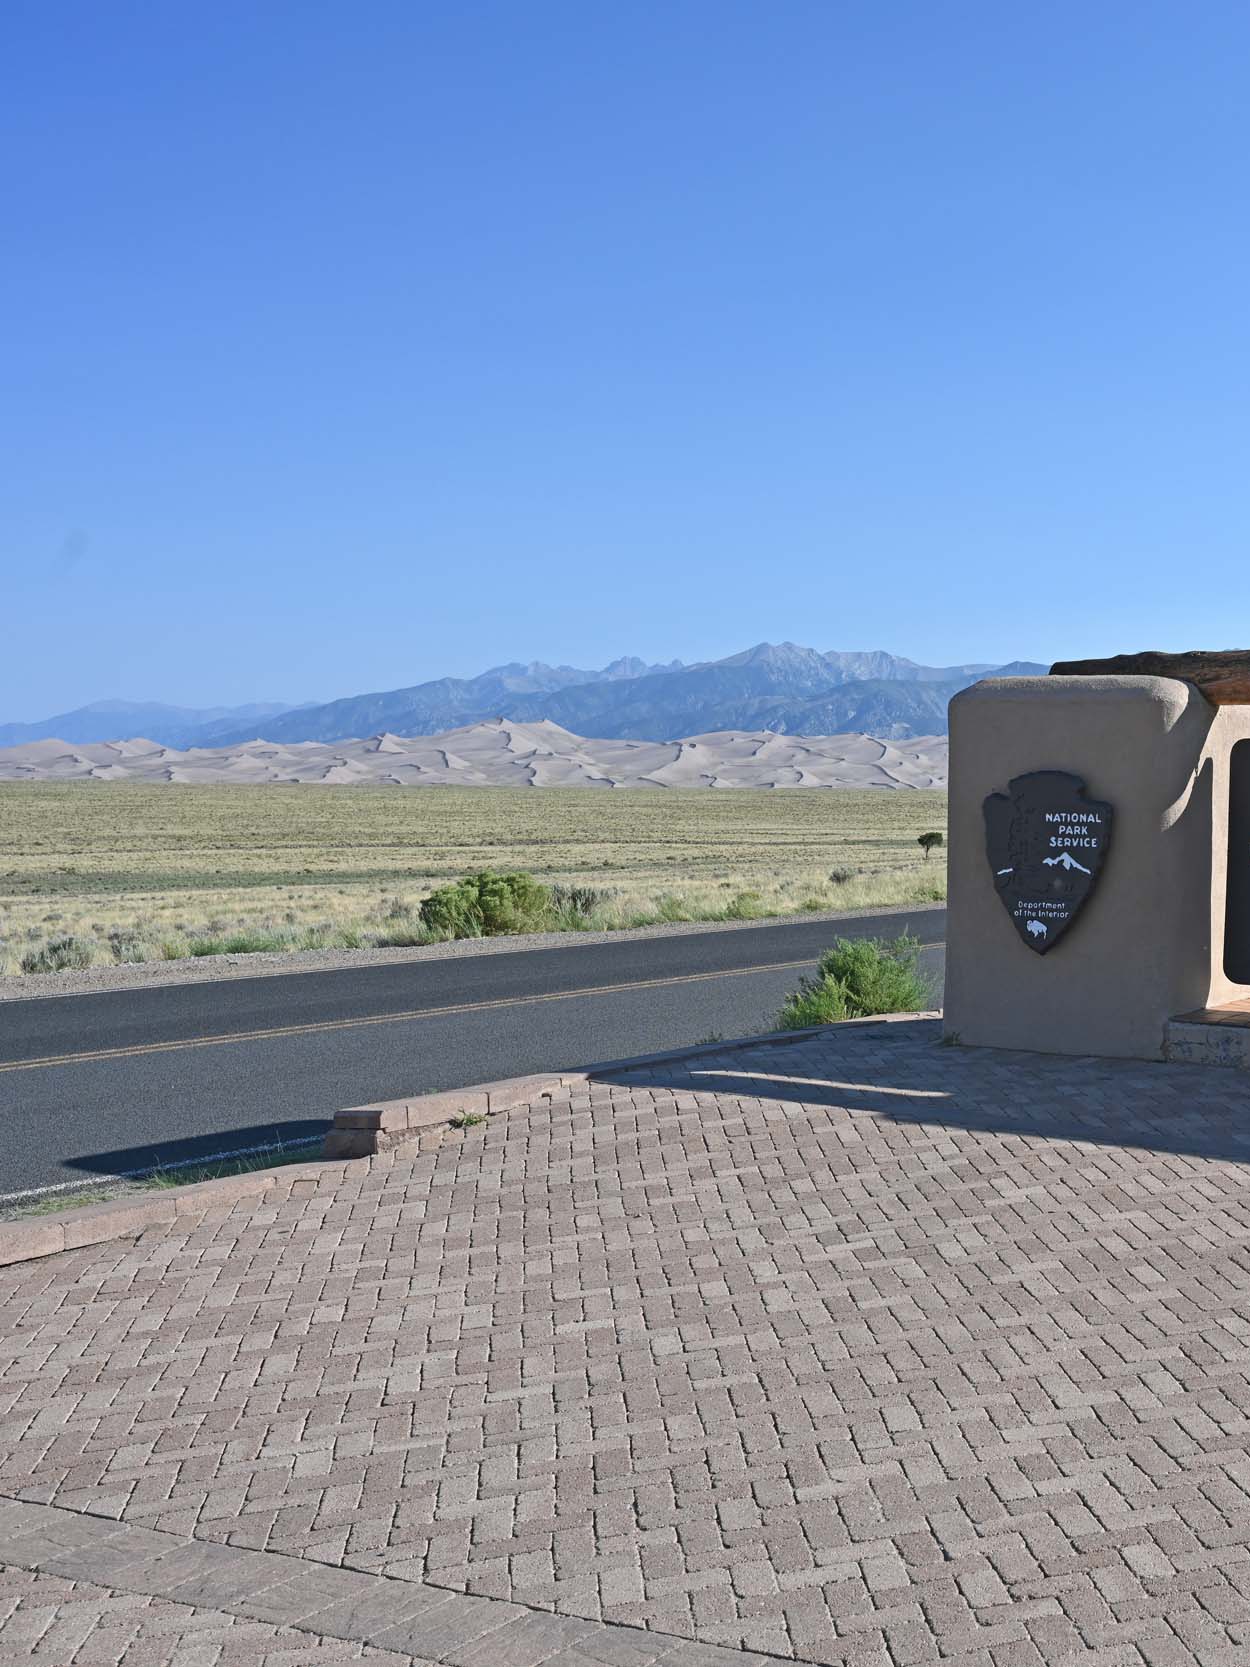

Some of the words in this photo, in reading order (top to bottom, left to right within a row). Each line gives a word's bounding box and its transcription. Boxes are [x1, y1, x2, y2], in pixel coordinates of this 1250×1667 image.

[1046, 813, 1101, 822] NATIONAL
[1059, 826, 1087, 834] PARK
[1050, 837, 1096, 847] SERVICE
[1018, 900, 1065, 909] Department
[1024, 909, 1036, 917] the
[1038, 910, 1069, 918] Interior
